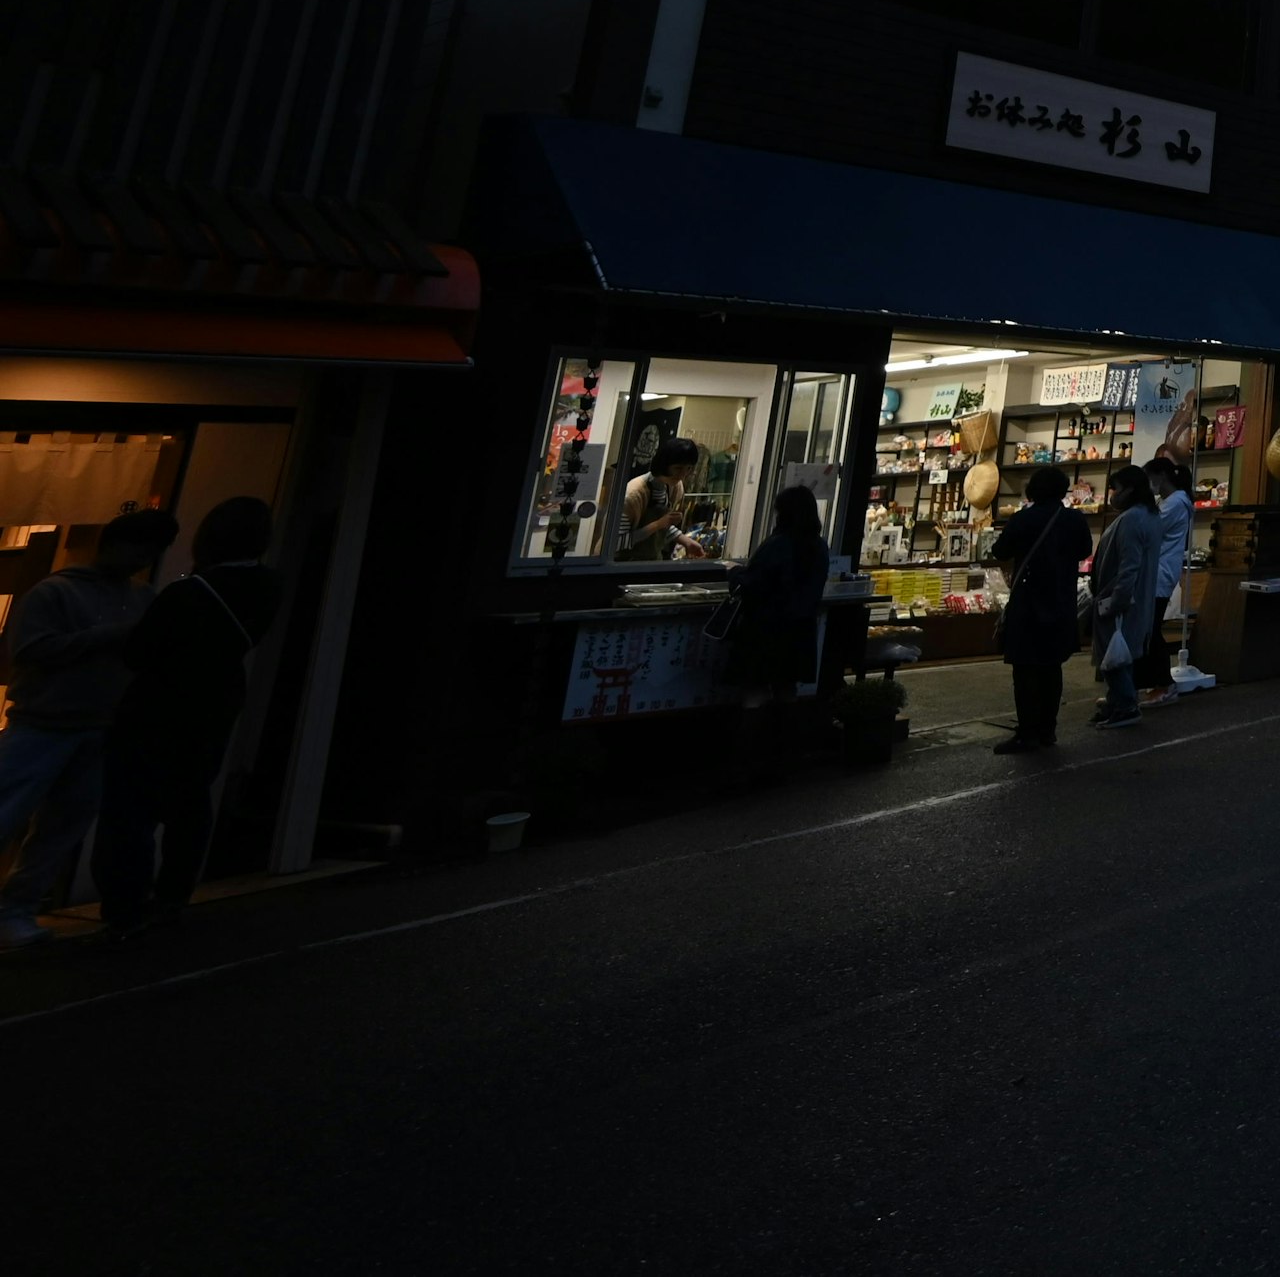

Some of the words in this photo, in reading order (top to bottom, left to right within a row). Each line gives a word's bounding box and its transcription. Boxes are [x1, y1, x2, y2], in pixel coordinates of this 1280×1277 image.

[966, 90, 1085, 138] お休み処
[1100, 107, 1202, 165] 杉山
